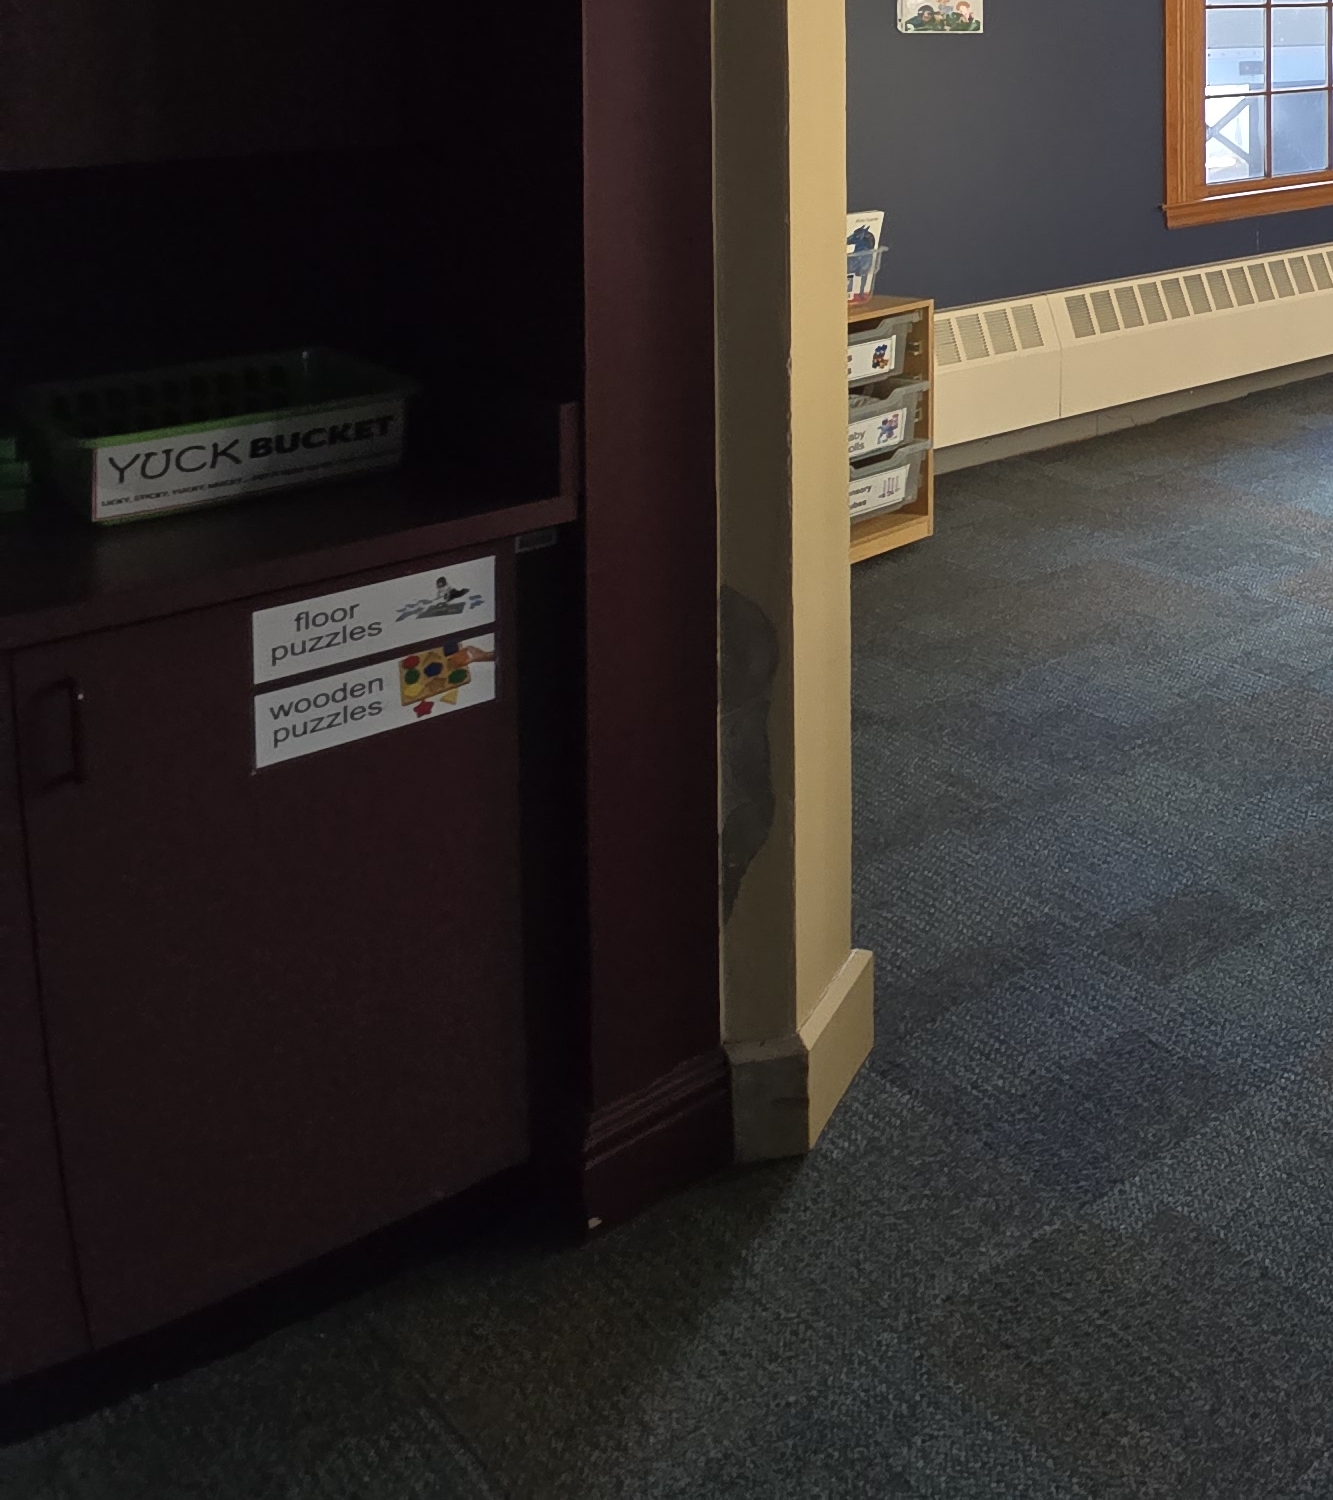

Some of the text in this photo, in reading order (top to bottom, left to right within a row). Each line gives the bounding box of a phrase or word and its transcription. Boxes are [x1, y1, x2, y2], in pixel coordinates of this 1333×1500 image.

[107, 438, 243, 486] YUCK
[248, 415, 394, 461] BUCKET
[294, 601, 360, 633] floor
[270, 620, 383, 667] puzzles
[268, 676, 385, 721] wooden
[272, 698, 383, 748] puzzles
